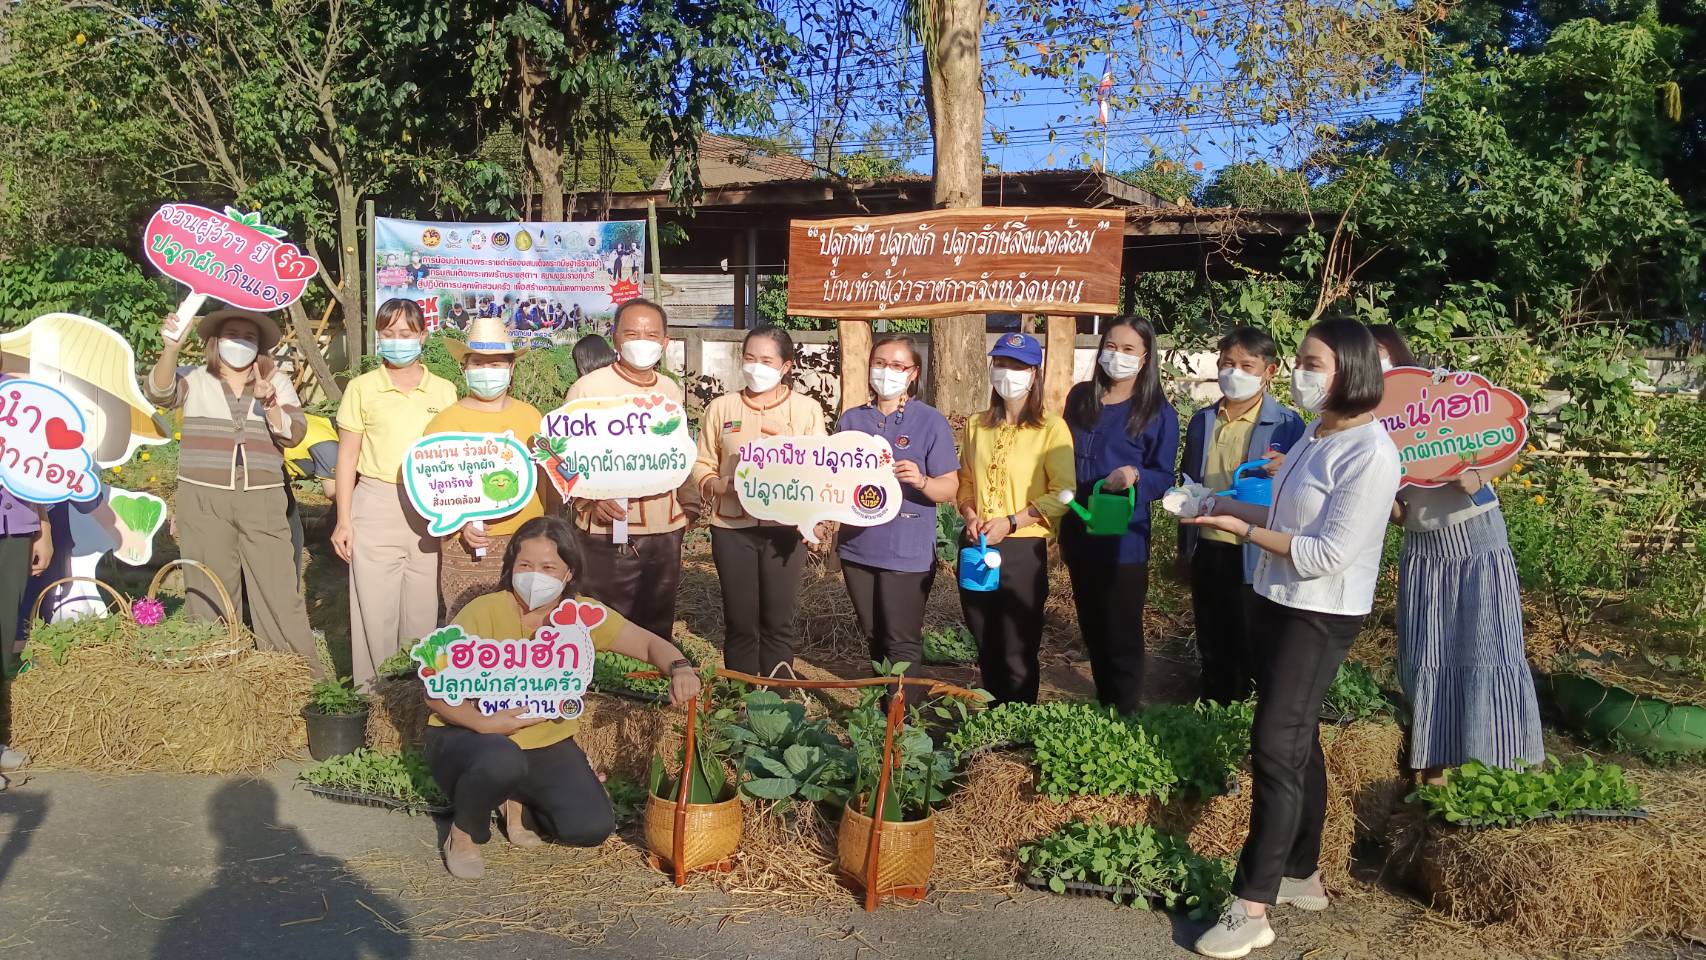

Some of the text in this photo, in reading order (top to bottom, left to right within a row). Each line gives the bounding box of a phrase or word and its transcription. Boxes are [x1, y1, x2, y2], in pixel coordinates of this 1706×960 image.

[161, 205, 247, 253] จวนผู้ว่าฯ
[278, 250, 305, 277] รัก
[880, 223, 936, 266] ปลูกผัก
[152, 234, 290, 306] ปลูกผักกินเอง
[823, 266, 1084, 311] บ้านพักผู้ว่าราชการจังหวัดน่าน
[546, 412, 652, 437] Kick off
[414, 440, 499, 460] คนน่าน ร่วมใจ
[565, 448, 688, 480] ปลูกผักสวนครัว
[739, 443, 878, 474] ปลูกพืช ปลูกรัก
[415, 458, 496, 477] ปลูกพืช ปลูกผัก
[428, 475, 473, 493] ปลูกรักษ์
[743, 477, 845, 506] ปลูกผัก กับ
[433, 494, 481, 507] สิ่งแวดล้อม
[451, 631, 579, 670] ฮอมฮัก
[429, 671, 582, 701] ปลูกผักสวนครัว
